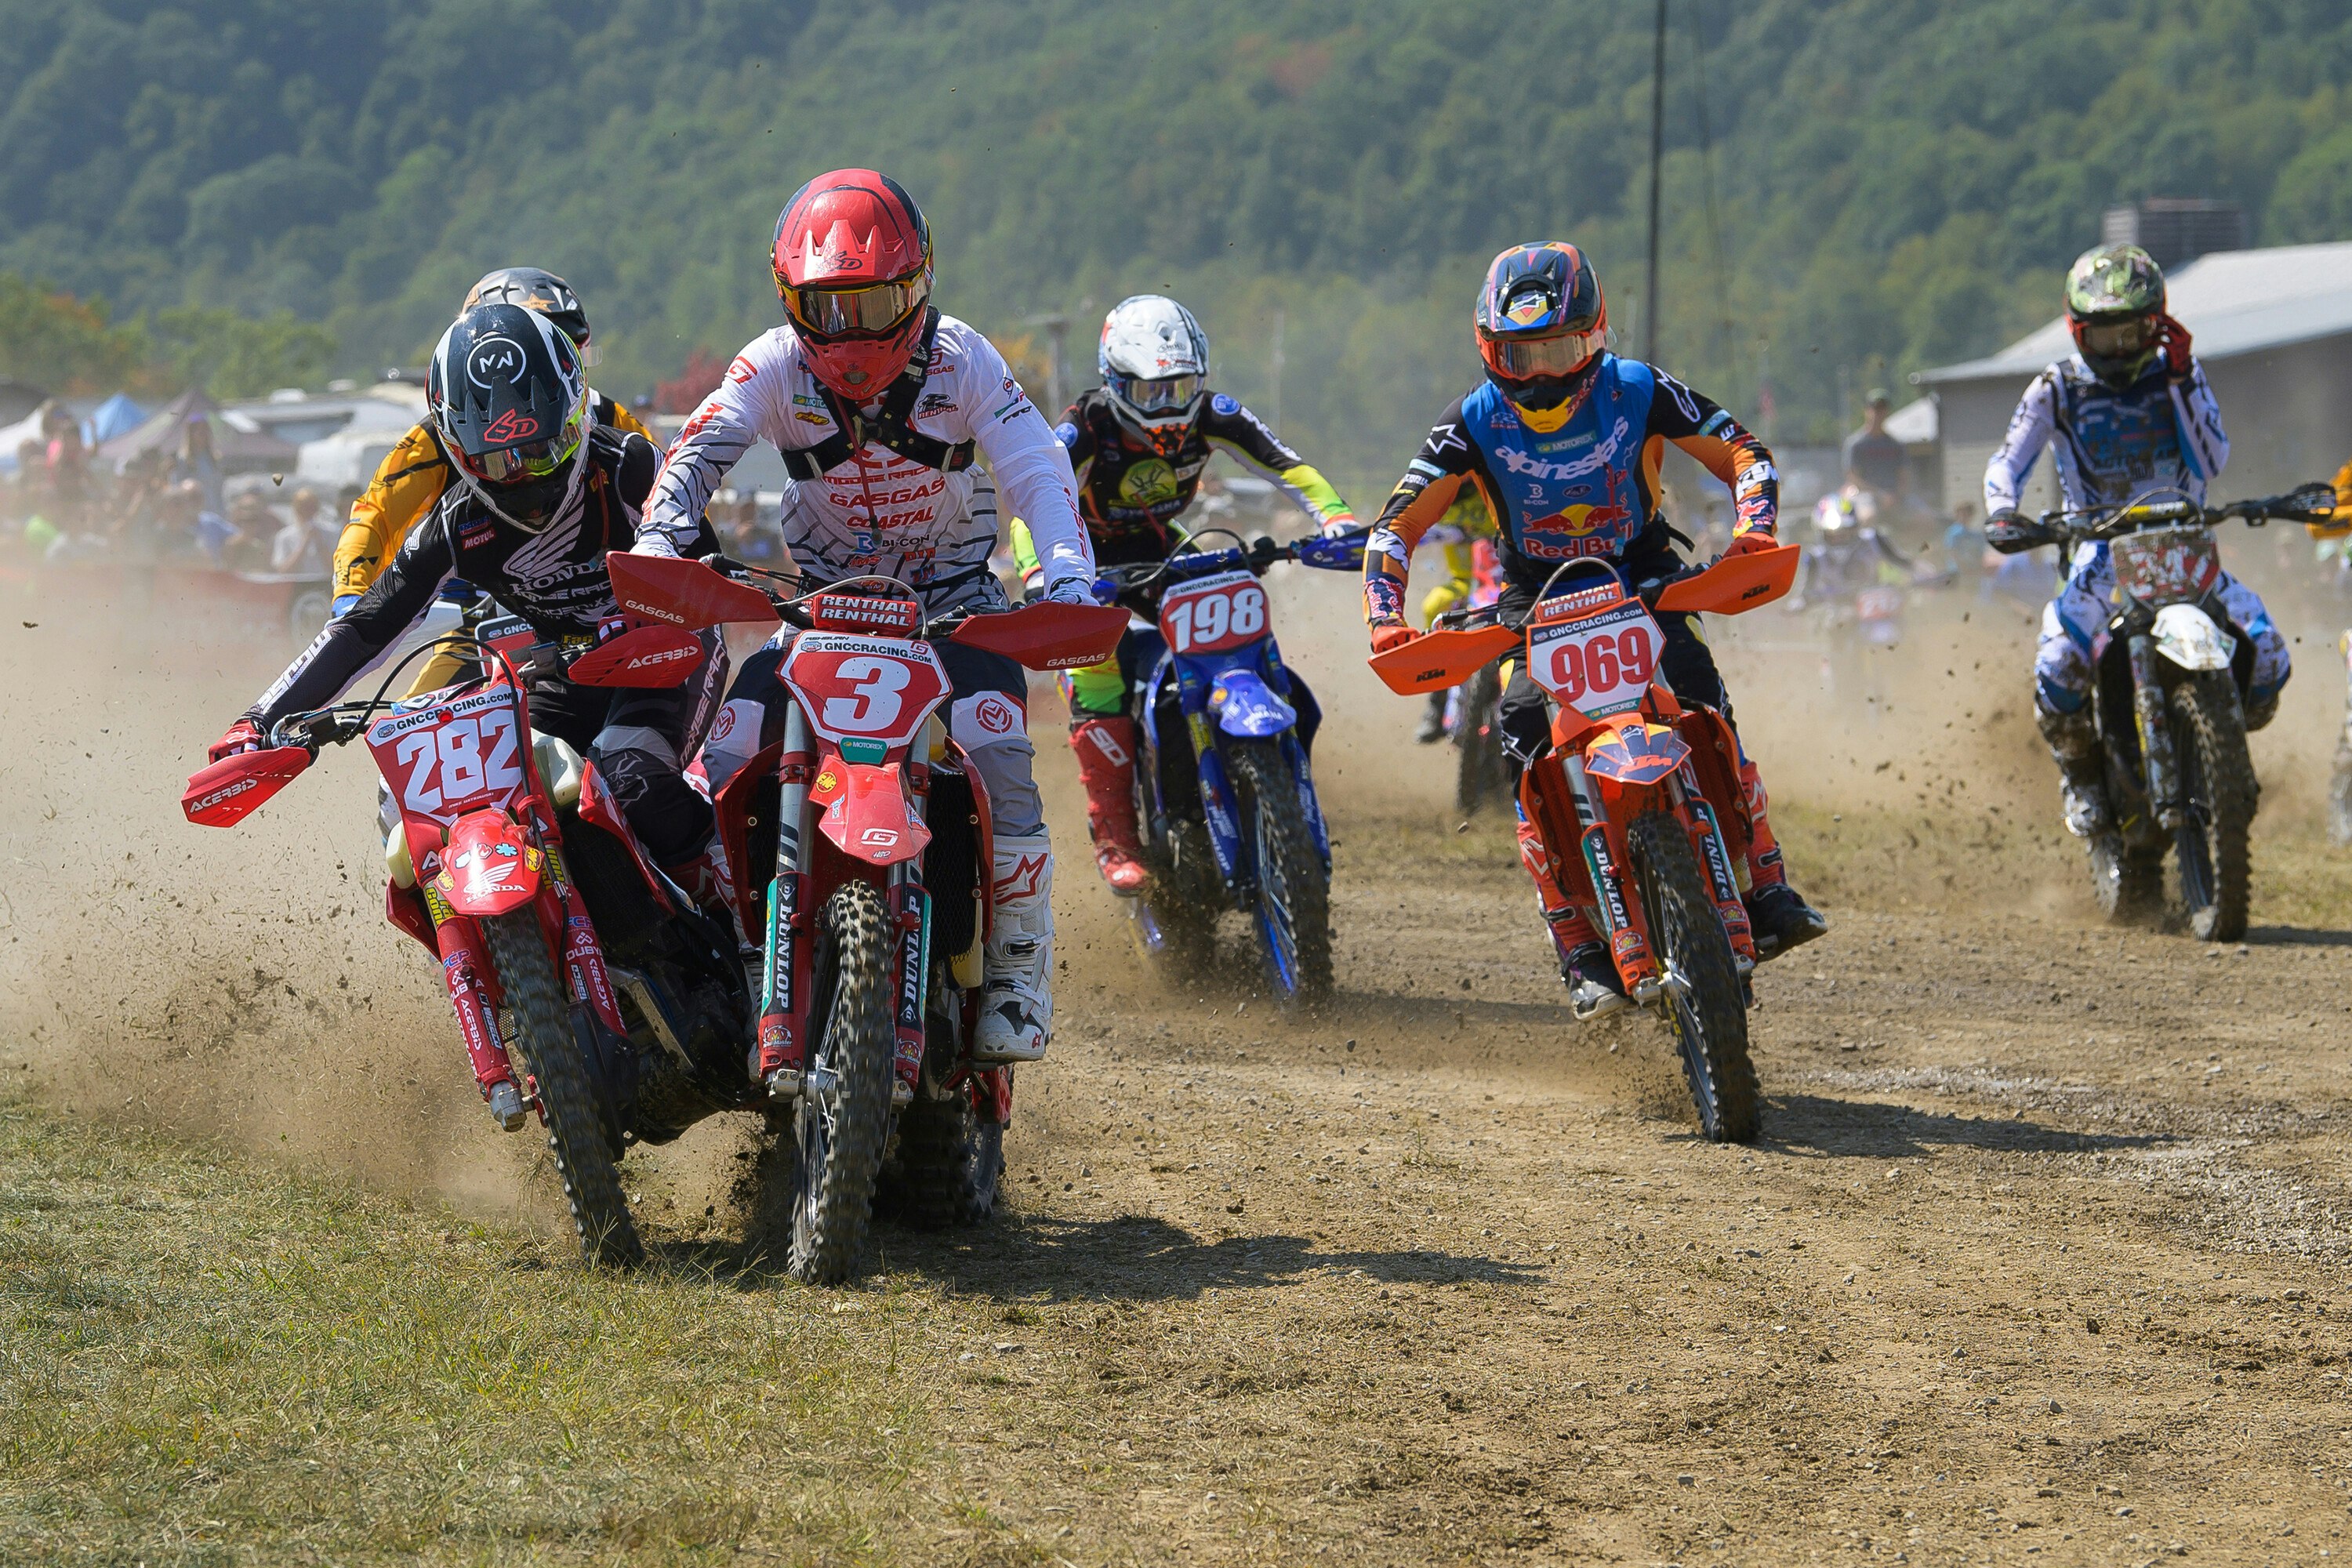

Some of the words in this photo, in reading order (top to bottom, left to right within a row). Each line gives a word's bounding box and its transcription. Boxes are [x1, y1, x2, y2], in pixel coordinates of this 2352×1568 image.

[484, 408, 539, 443] 6D
[1495, 416, 1629, 480] alpinestars
[1552, 433, 1594, 452] MOTOREX
[829, 476, 946, 508] GASGAS
[847, 505, 935, 530] COASTAL
[464, 531, 494, 548] MOTUL
[882, 534, 931, 547] BI-CON
[1523, 537, 1581, 559] Red
[510, 559, 609, 594] HONDA
[821, 596, 912, 614] RENTHAL
[1544, 591, 1618, 618] RENTHAL
[1741, 584, 1770, 601] KTM
[625, 599, 685, 624] GASGAS
[820, 608, 911, 626] RENTHAL
[1167, 587, 1265, 653] 198
[1548, 608, 1643, 638] GNCCRACING.COM
[824, 642, 932, 664] GNCCRACING.COM
[1047, 653, 1107, 667] GASGAS
[1551, 626, 1653, 703] 969
[1416, 668, 1446, 683] KTM
[822, 656, 912, 733] 3
[1600, 699, 1637, 715] MOTOREX
[852, 742, 883, 750] MOTOREX
[396, 709, 523, 814] 282
[1696, 808, 1727, 885] DUNLP
[466, 884, 528, 905] HONDA
[776, 902, 793, 1008] DUNLOP
[904, 895, 921, 1004] DUNLP
[450, 979, 485, 1004] DUBA
